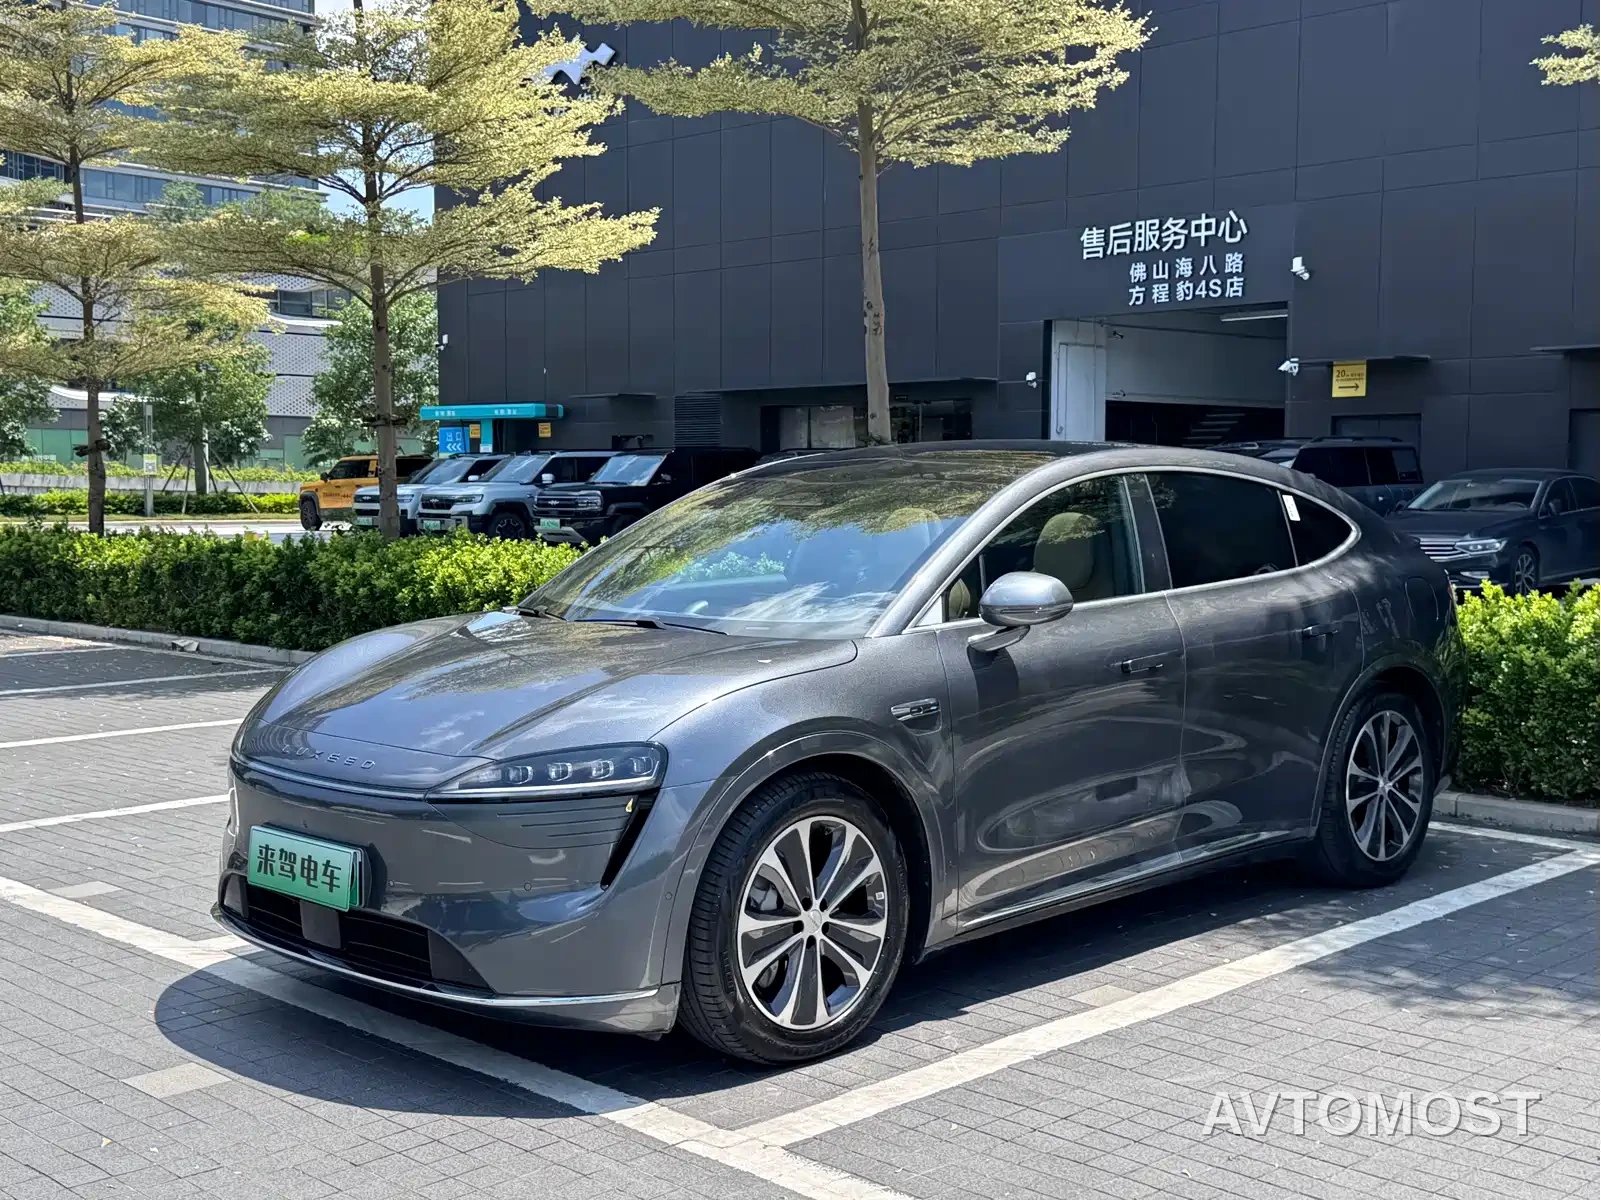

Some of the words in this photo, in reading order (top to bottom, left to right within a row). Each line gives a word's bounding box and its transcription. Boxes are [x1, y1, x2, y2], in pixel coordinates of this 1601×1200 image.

[1080, 210, 1248, 260] 售后服务中心
[1129, 252, 1245, 284] 佛山海八路
[1128, 276, 1245, 307] 方程豹4S店
[281, 744, 376, 769] LUXEED
[256, 843, 342, 893] 来驾电车
